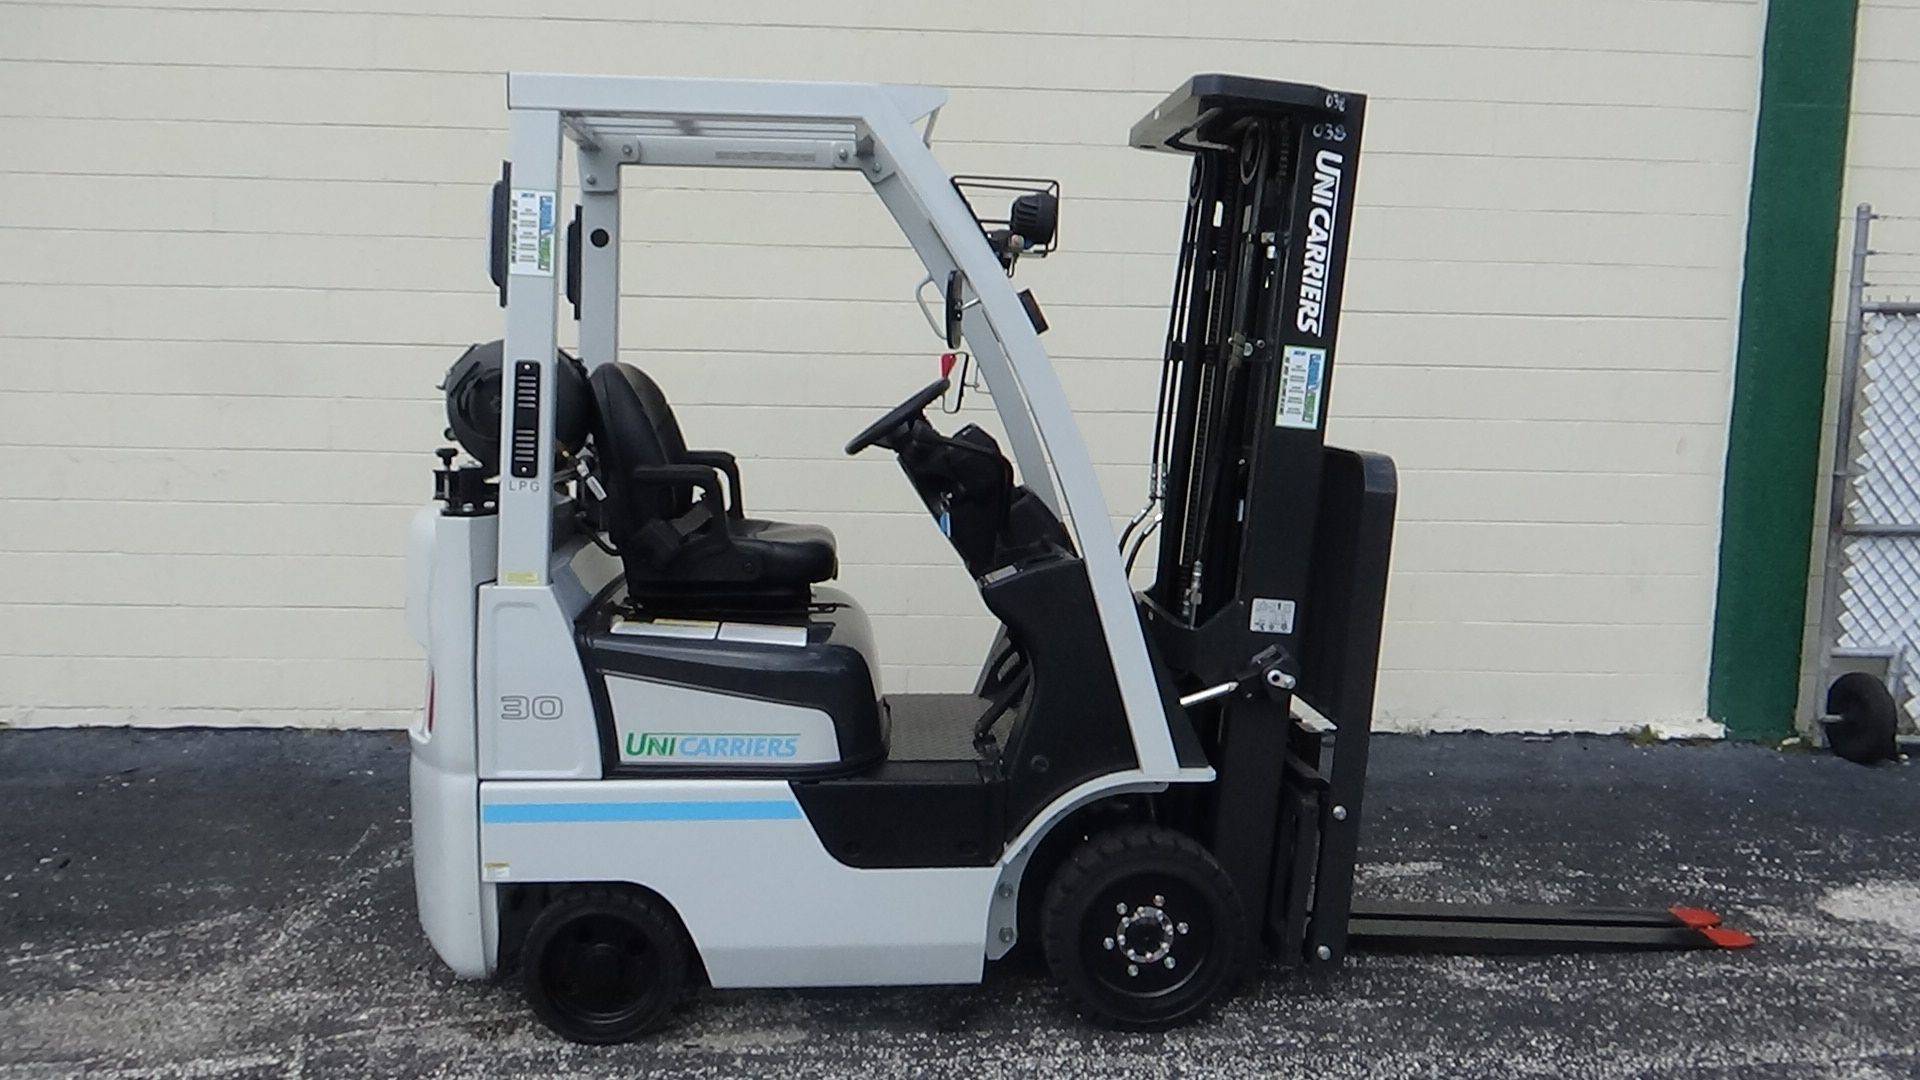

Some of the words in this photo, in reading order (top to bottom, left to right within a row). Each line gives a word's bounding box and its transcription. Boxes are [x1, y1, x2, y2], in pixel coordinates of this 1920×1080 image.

[1312, 123, 1347, 141] 038
[1296, 150, 1343, 337] UNICARRIERS
[509, 480, 540, 492] LPG
[501, 695, 563, 720] 30
